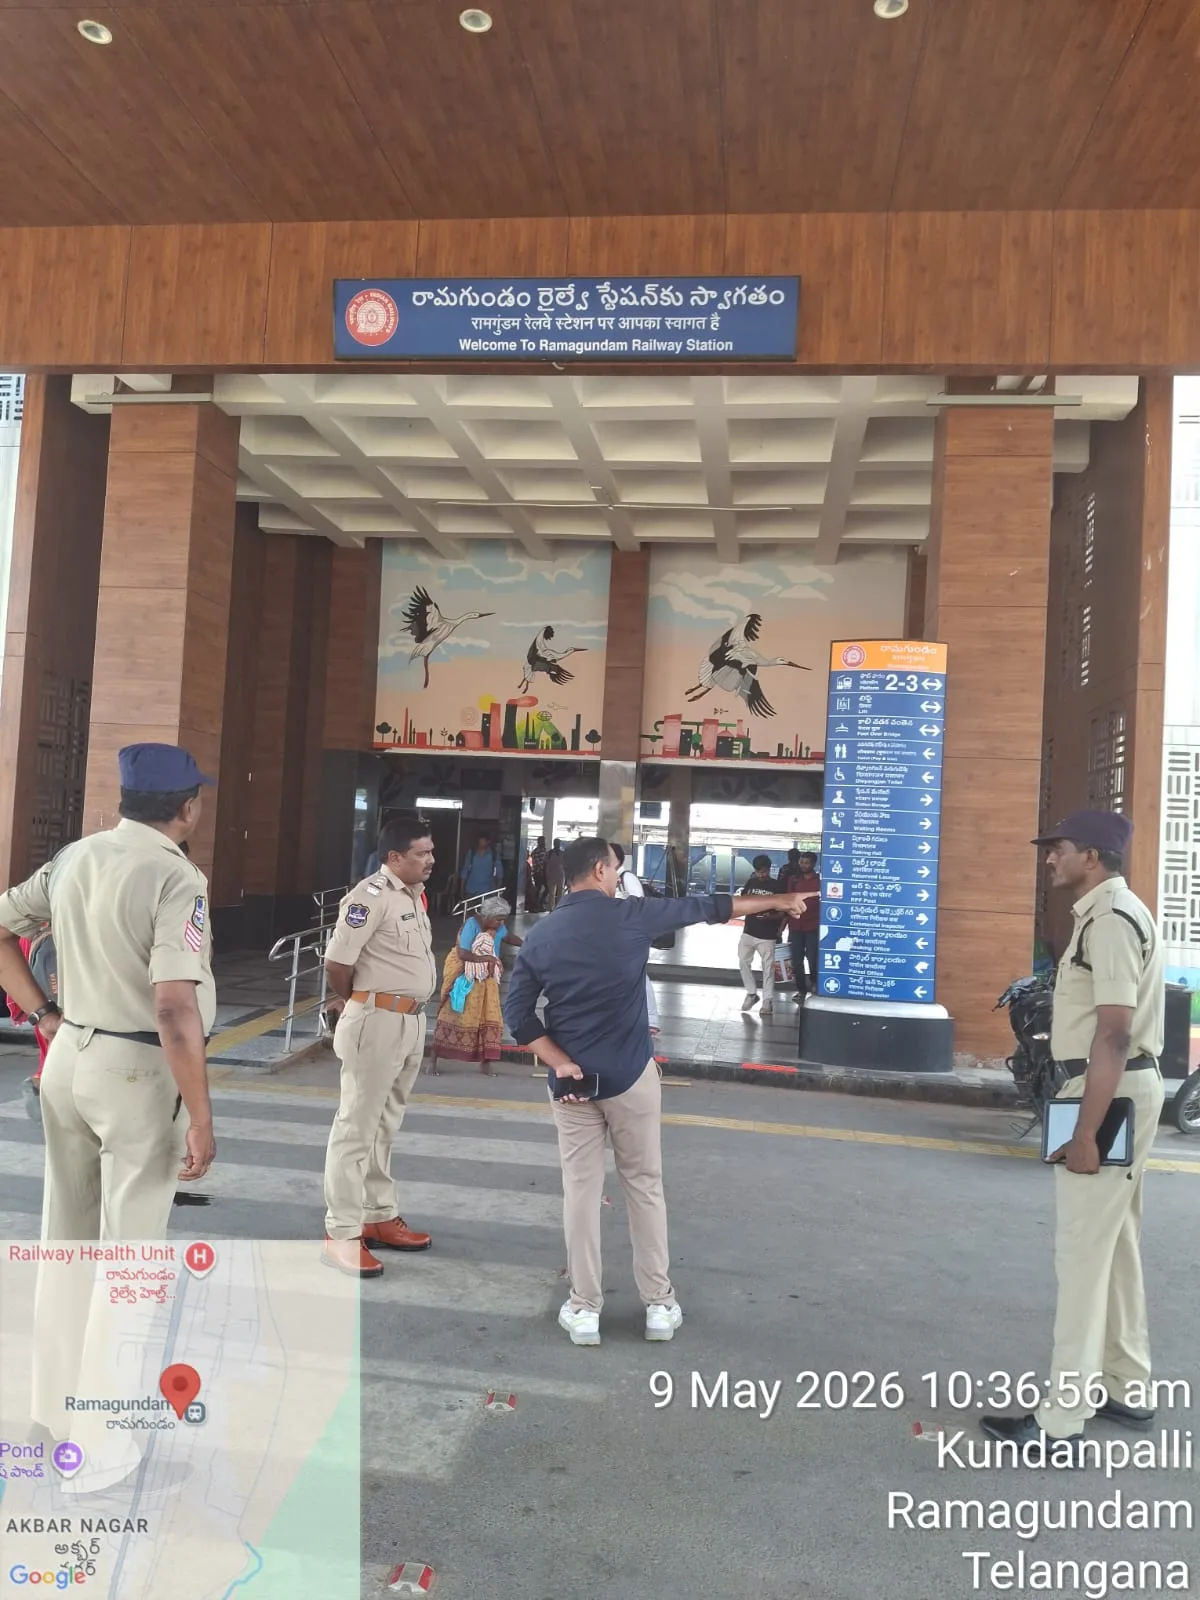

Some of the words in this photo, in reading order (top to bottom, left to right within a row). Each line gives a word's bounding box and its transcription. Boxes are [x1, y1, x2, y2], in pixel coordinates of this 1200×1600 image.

[412, 285, 531, 307] రామగుండం
[537, 283, 590, 311] రైల్వే
[690, 284, 785, 310] స్వాగతం
[471, 313, 521, 335] रामगुंडम
[524, 313, 552, 330] रेलवे
[556, 312, 594, 330] स्टेशन
[597, 316, 615, 330] पर
[618, 316, 660, 330] आपका
[664, 316, 707, 330] स्वागत
[710, 311, 721, 331] है
[459, 338, 517, 351] Welcome
[520, 338, 536, 351] To
[539, 338, 628, 354] Ramagundam
[632, 338, 683, 354] Railway
[686, 338, 733, 351] Station
[885, 673, 918, 692] 2-3
